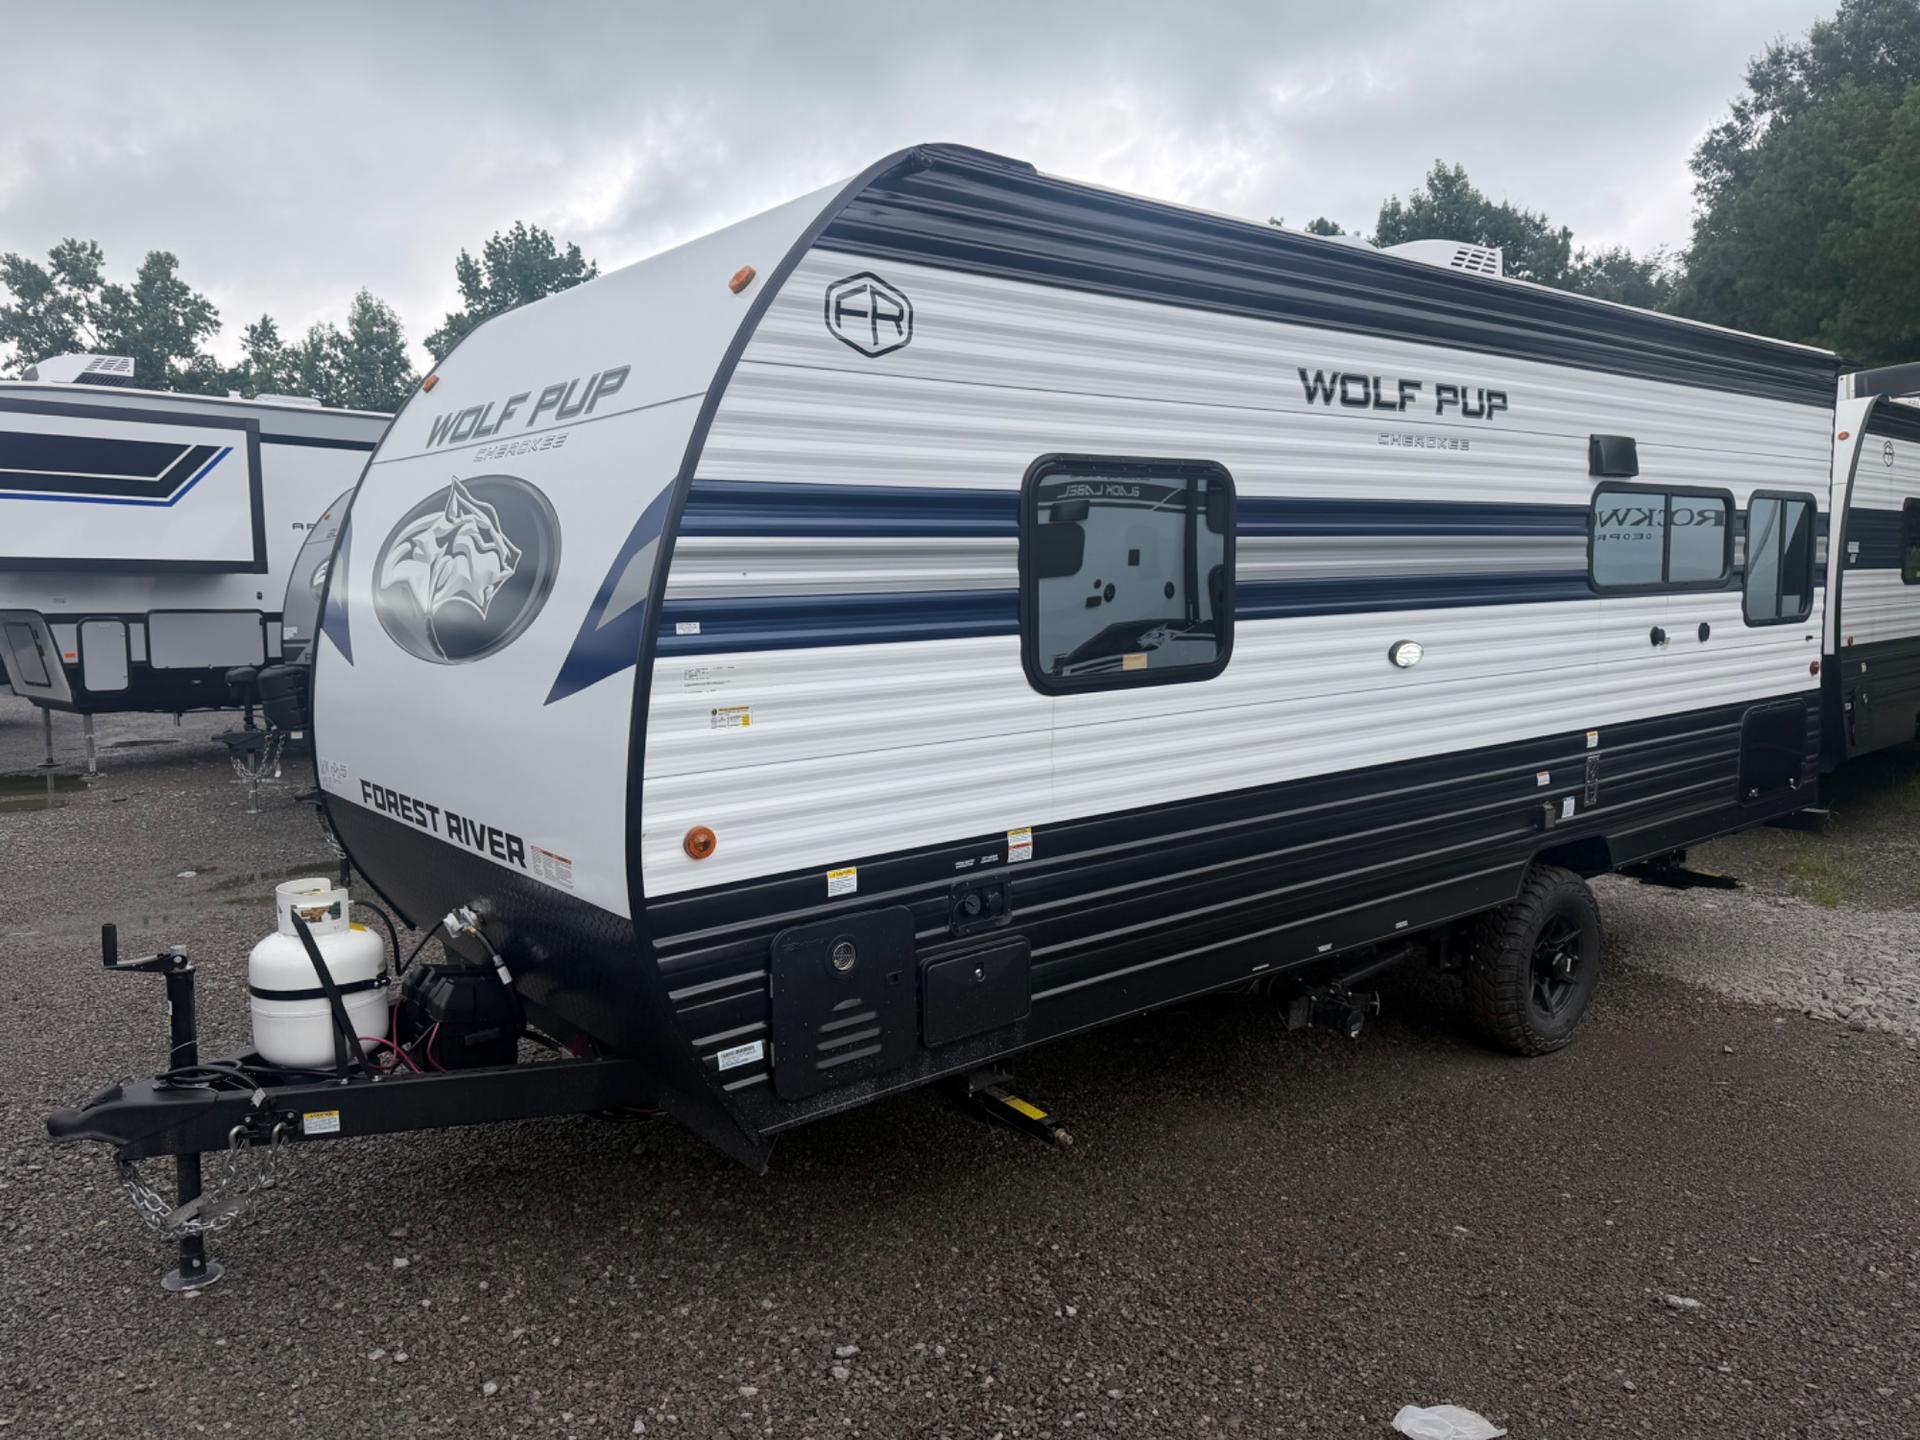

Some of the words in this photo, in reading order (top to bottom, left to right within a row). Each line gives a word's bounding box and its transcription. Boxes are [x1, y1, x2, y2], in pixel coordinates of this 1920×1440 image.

[426, 391, 532, 449] WOLF
[525, 364, 632, 428] PUP
[1297, 367, 1423, 412] WOLF
[1435, 382, 1508, 420] PUP
[473, 432, 569, 463] CHEROKEE
[1376, 431, 1471, 452] CHEROKEE
[360, 778, 440, 833] FOREST
[444, 809, 527, 869] RIVER
